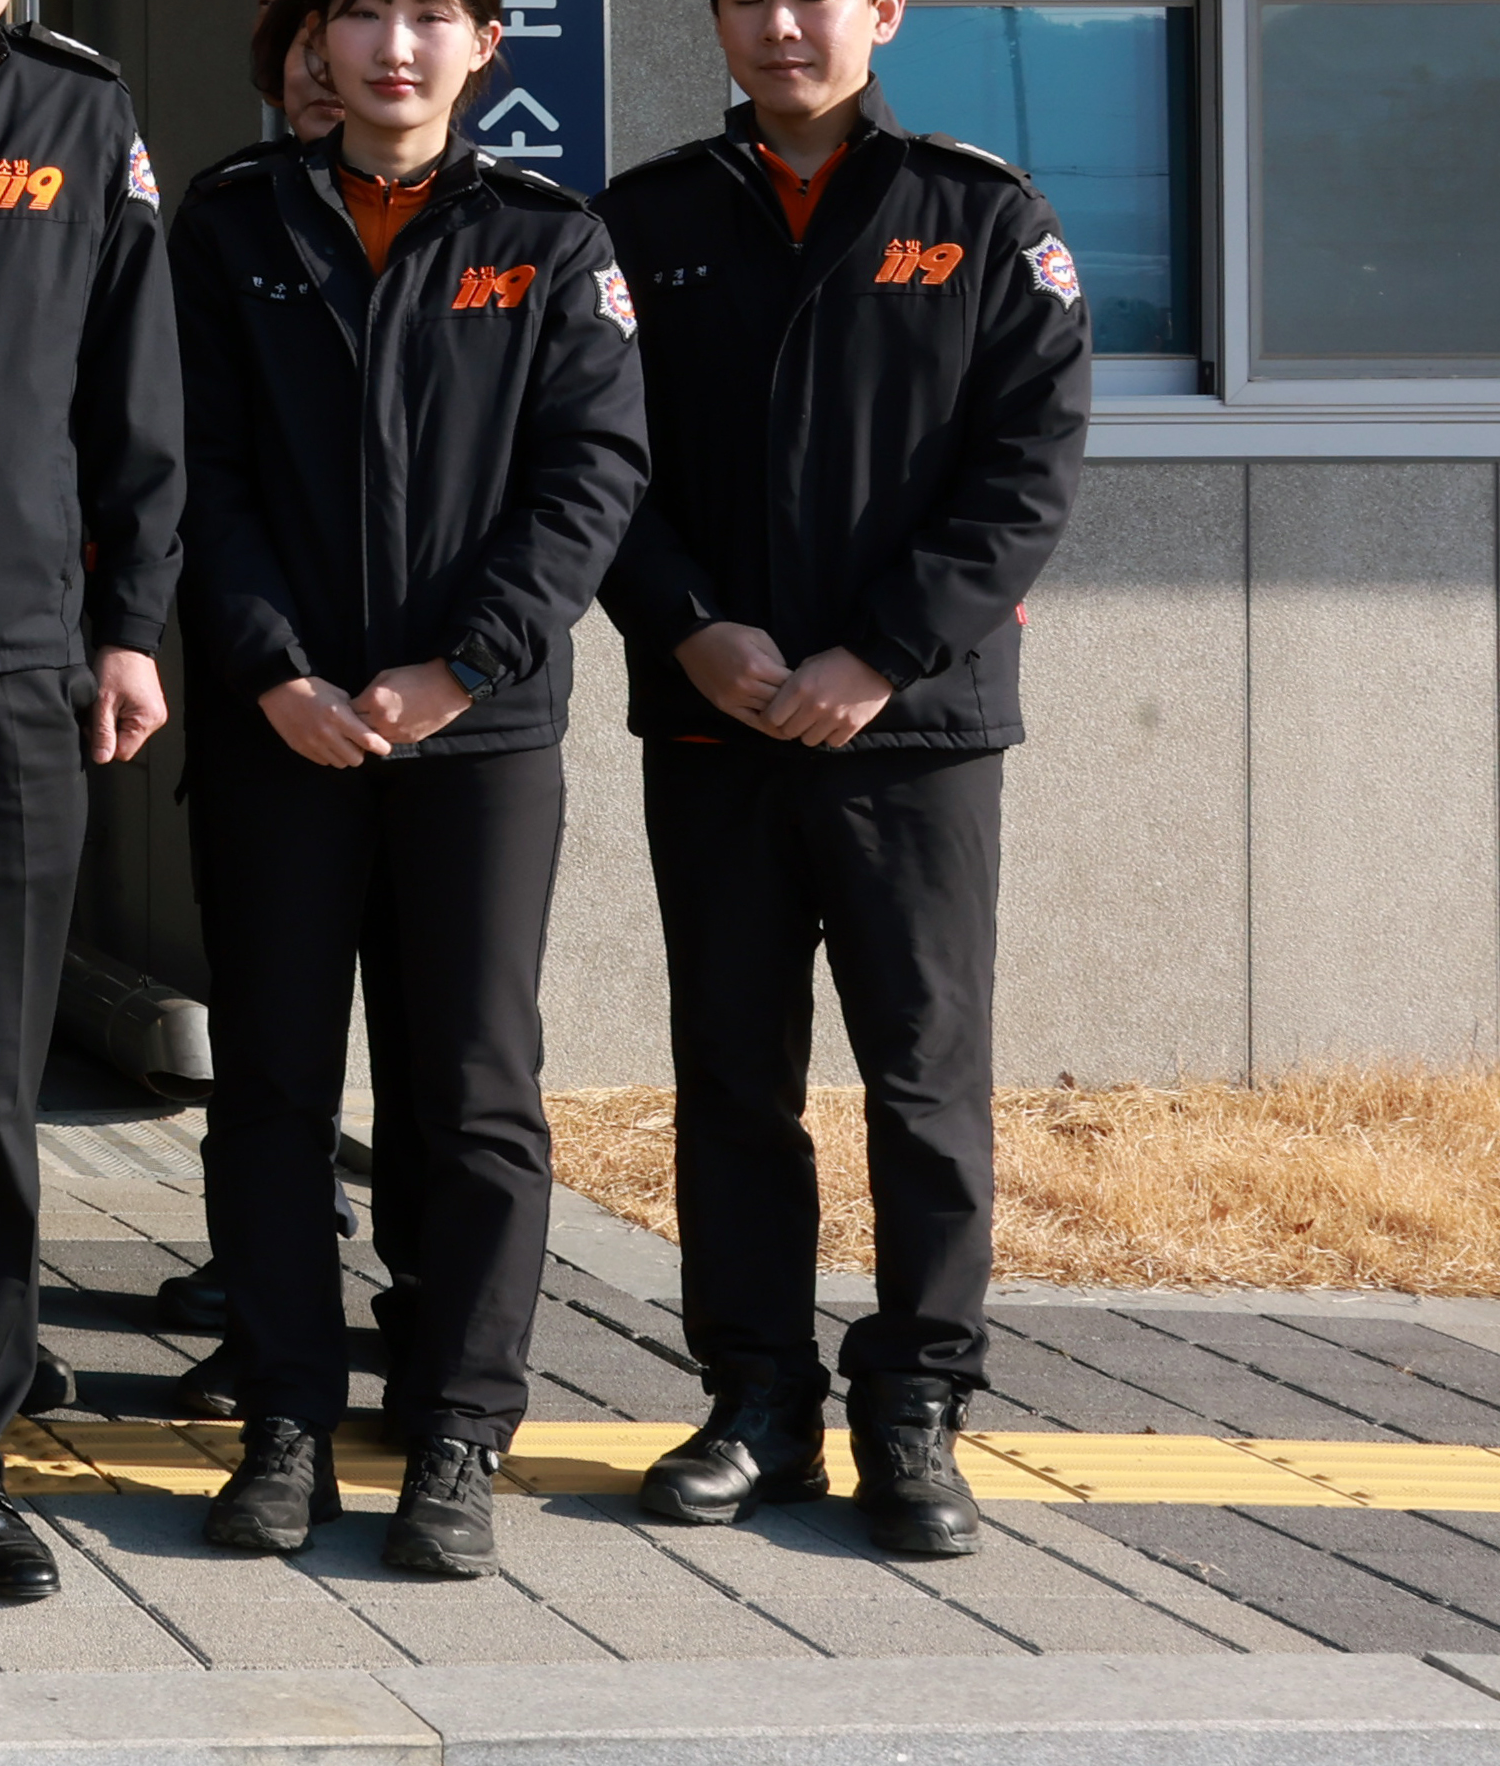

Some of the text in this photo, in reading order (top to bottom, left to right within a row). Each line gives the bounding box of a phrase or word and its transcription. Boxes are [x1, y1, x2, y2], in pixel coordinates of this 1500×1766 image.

[883, 238, 923, 254] 소방
[460, 266, 496, 281] 소방
[873, 243, 963, 285] 119
[452, 265, 536, 309] 119
